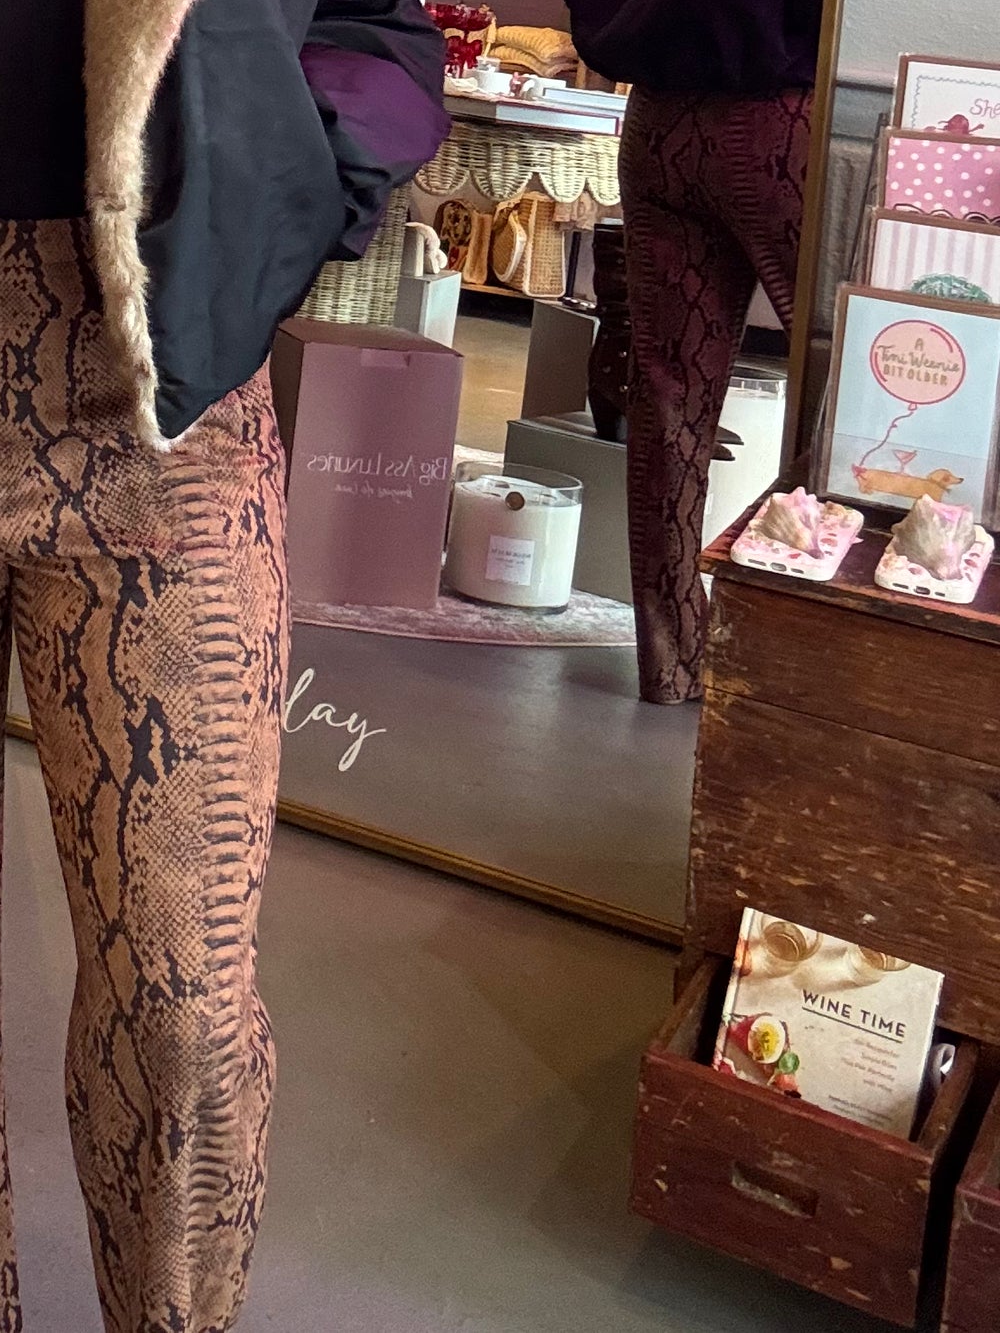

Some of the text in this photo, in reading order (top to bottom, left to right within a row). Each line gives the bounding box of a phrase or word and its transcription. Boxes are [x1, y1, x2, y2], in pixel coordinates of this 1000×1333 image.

[914, 337, 924, 351] A
[883, 363, 948, 386] BIT OLDER
[284, 668, 387, 771] lay
[802, 988, 907, 1037] WINE TIME
